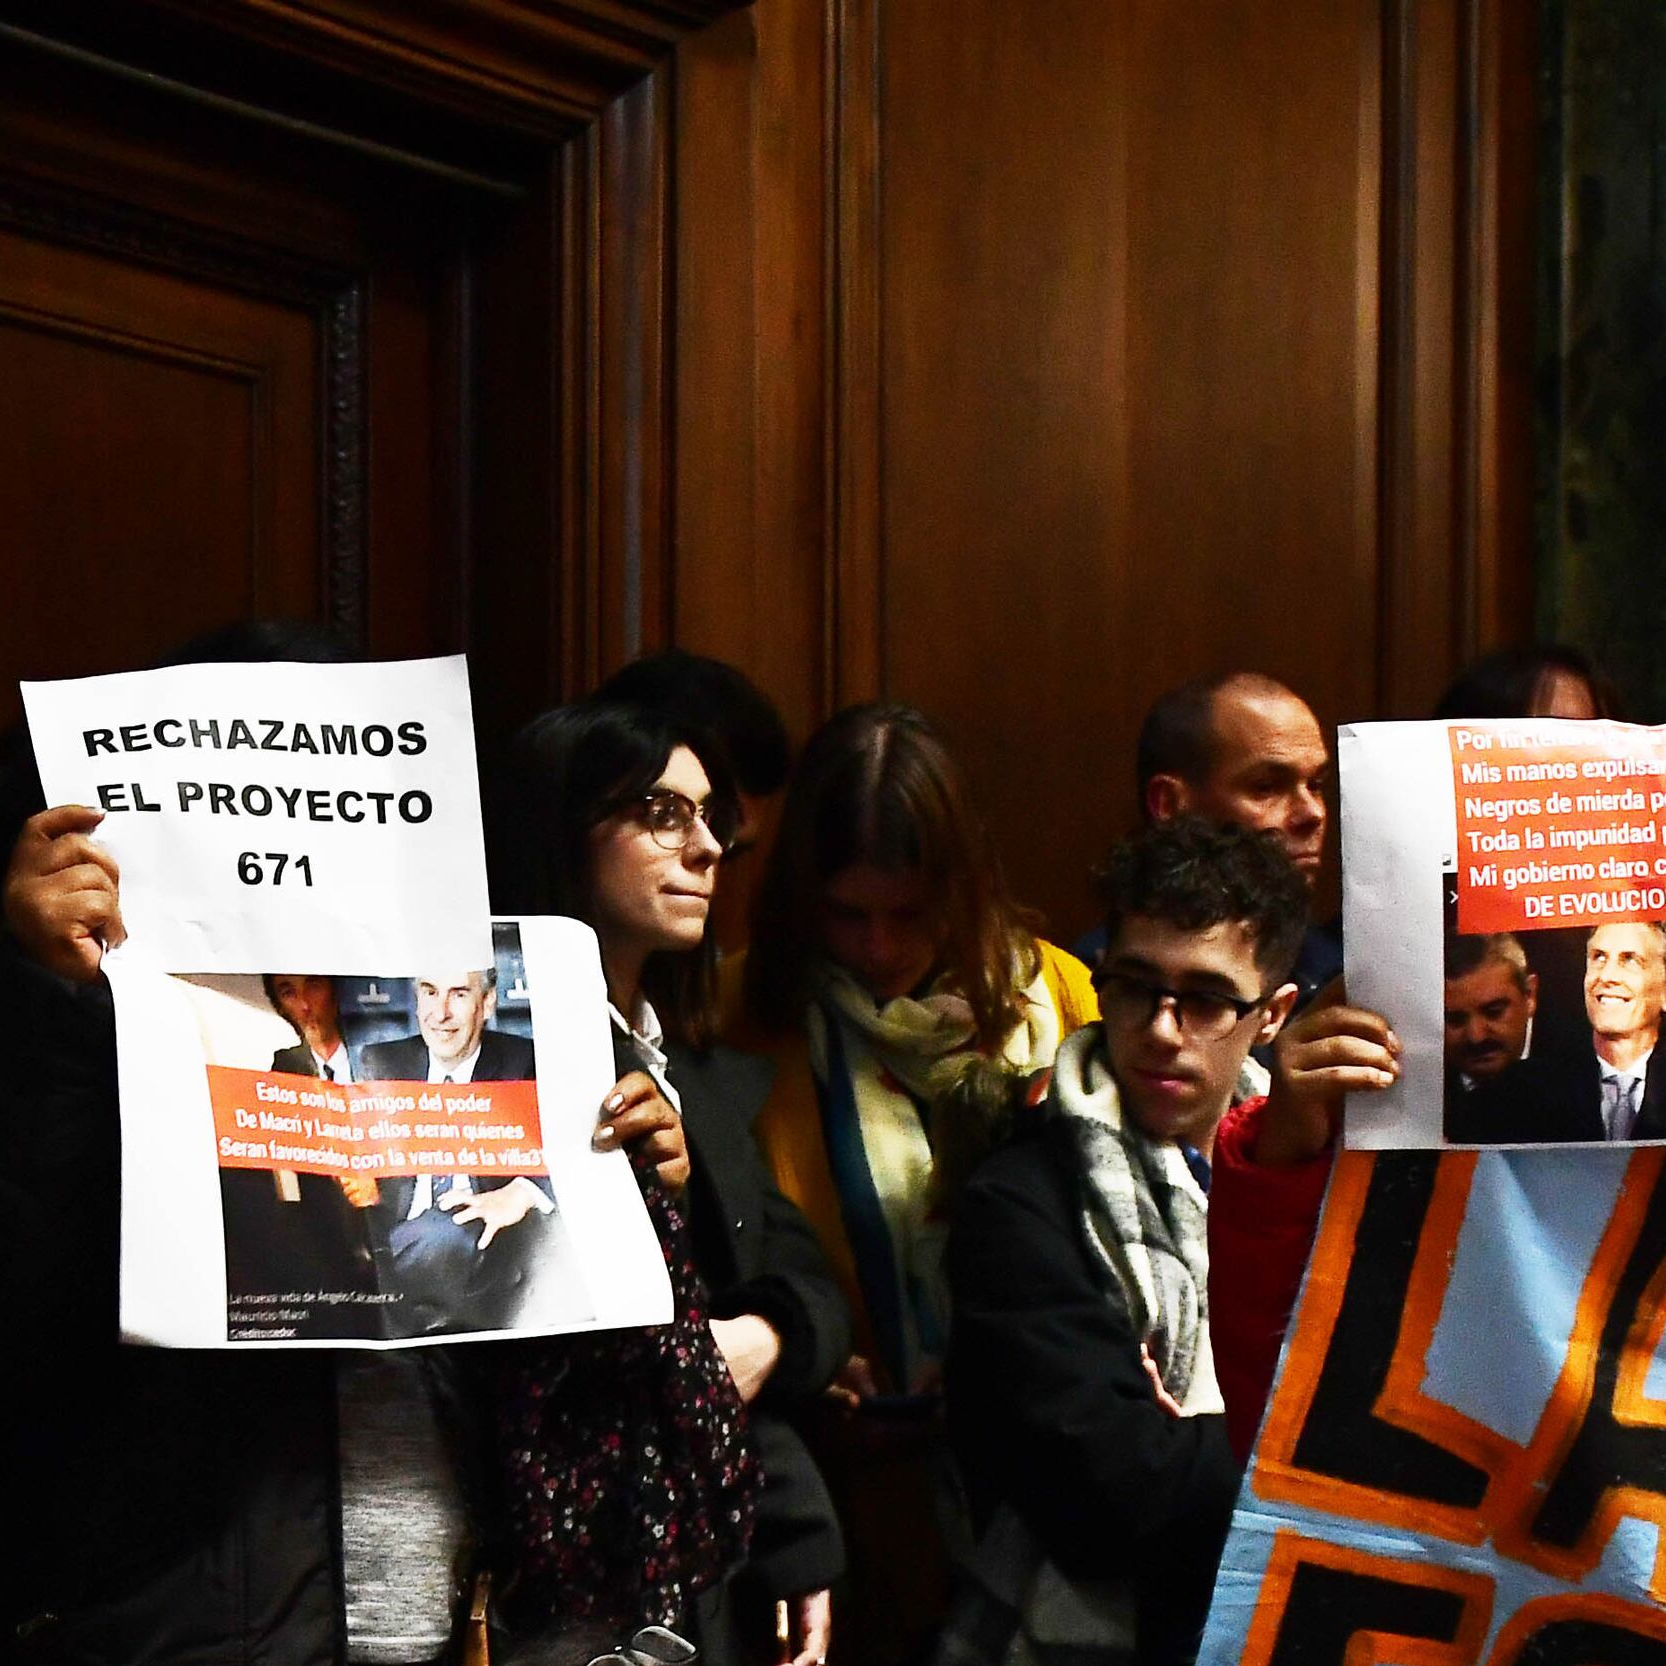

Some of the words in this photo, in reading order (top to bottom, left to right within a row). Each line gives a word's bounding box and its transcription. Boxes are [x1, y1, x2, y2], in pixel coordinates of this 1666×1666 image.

[82, 718, 427, 758] RECHAZAMOS
[1462, 762, 1501, 784] Mis
[1507, 763, 1578, 781] manos
[96, 783, 161, 812] EL
[176, 782, 433, 825] PROYECTO
[1465, 797, 1541, 822] Negros
[1546, 792, 1572, 814] de
[1576, 788, 1645, 812] mierda
[1466, 829, 1520, 852] Toda
[1524, 827, 1545, 849] la
[1549, 820, 1656, 852] impunidad
[237, 852, 313, 887] 671
[1469, 864, 1497, 887] Mi
[1503, 860, 1595, 890] gobierno
[1598, 857, 1649, 880] claro
[1524, 895, 1556, 918] DE
[256, 1081, 298, 1105] Estos
[349, 1093, 416, 1115] amigos
[445, 1094, 492, 1116] poder
[235, 1109, 257, 1129] De
[350, 1153, 384, 1171] con
